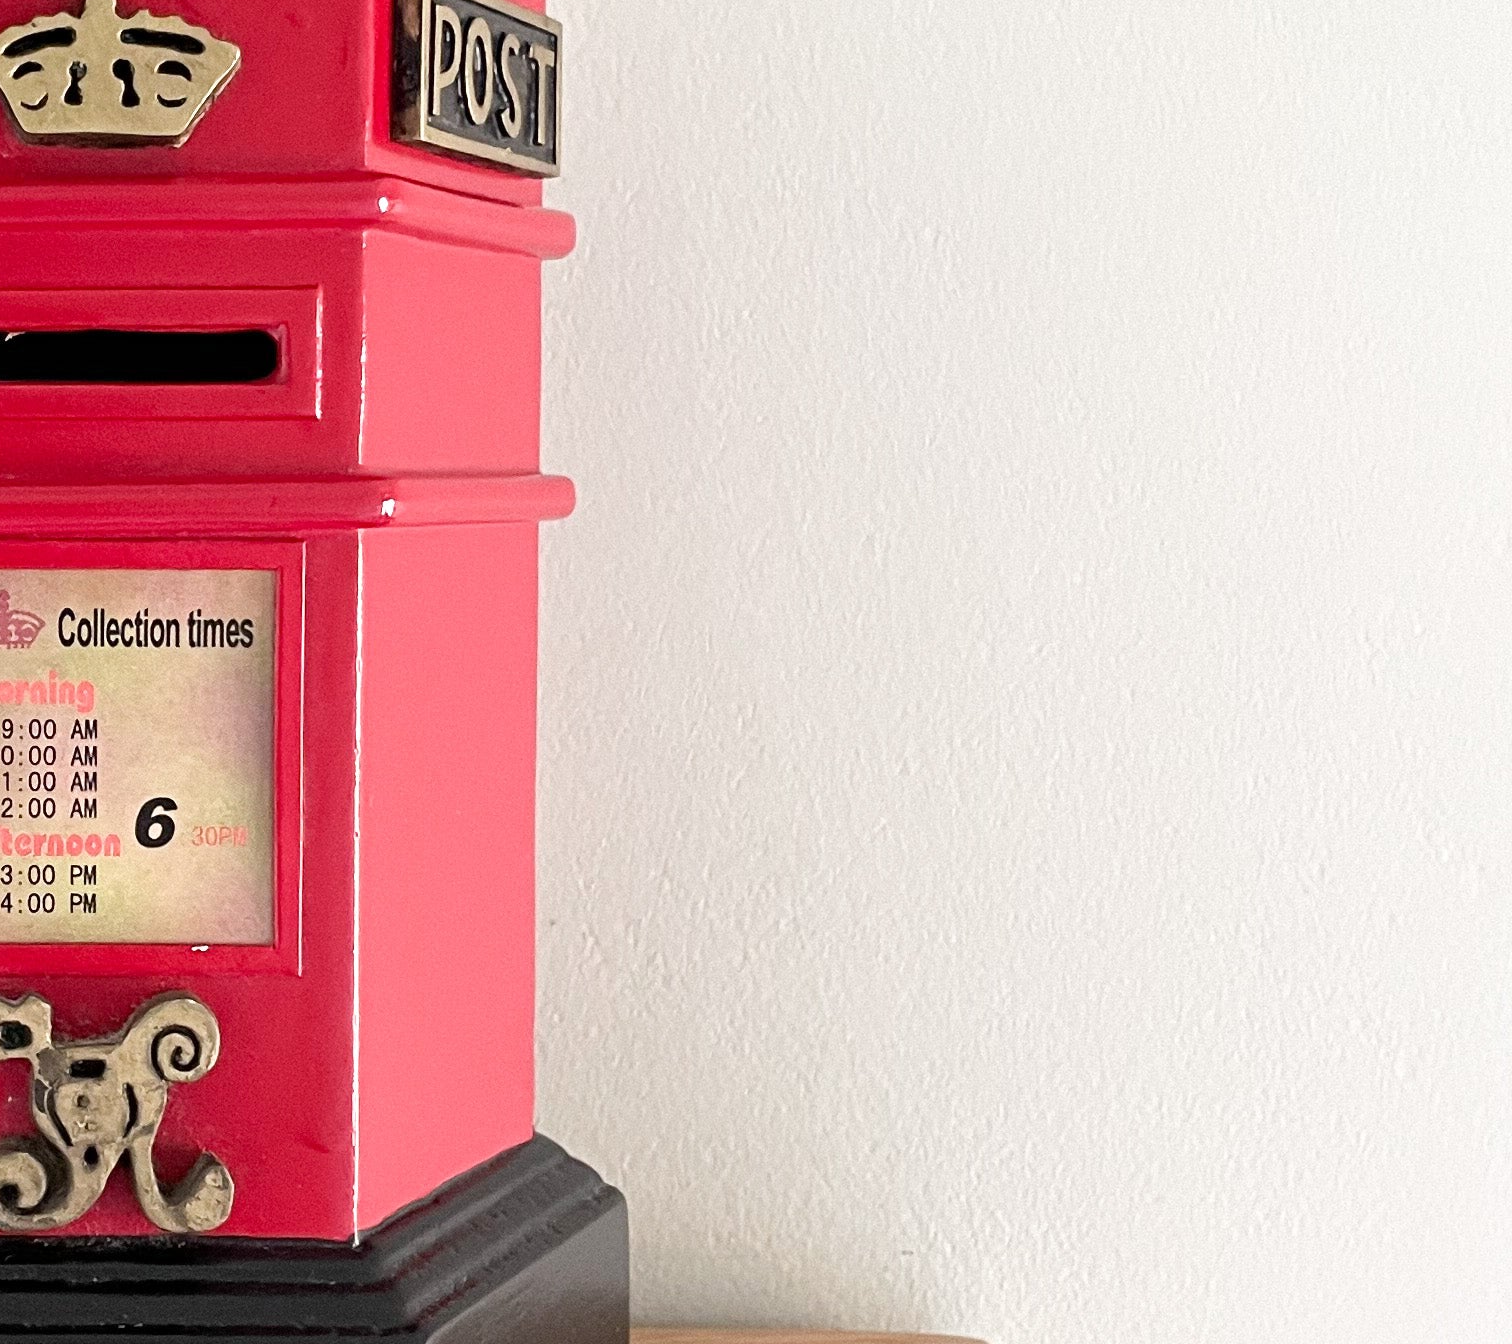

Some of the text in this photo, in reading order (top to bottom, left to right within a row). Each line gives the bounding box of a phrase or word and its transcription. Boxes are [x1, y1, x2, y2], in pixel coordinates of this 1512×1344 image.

[432, 4, 555, 146] POST
[58, 608, 255, 648] Collection times
[1, 719, 98, 740] 9:00 AM
[71, 746, 98, 767] AM
[71, 772, 98, 792] AM
[71, 798, 98, 819] AM
[135, 797, 178, 848] 6
[70, 865, 98, 886] PM
[70, 893, 98, 914] PM
